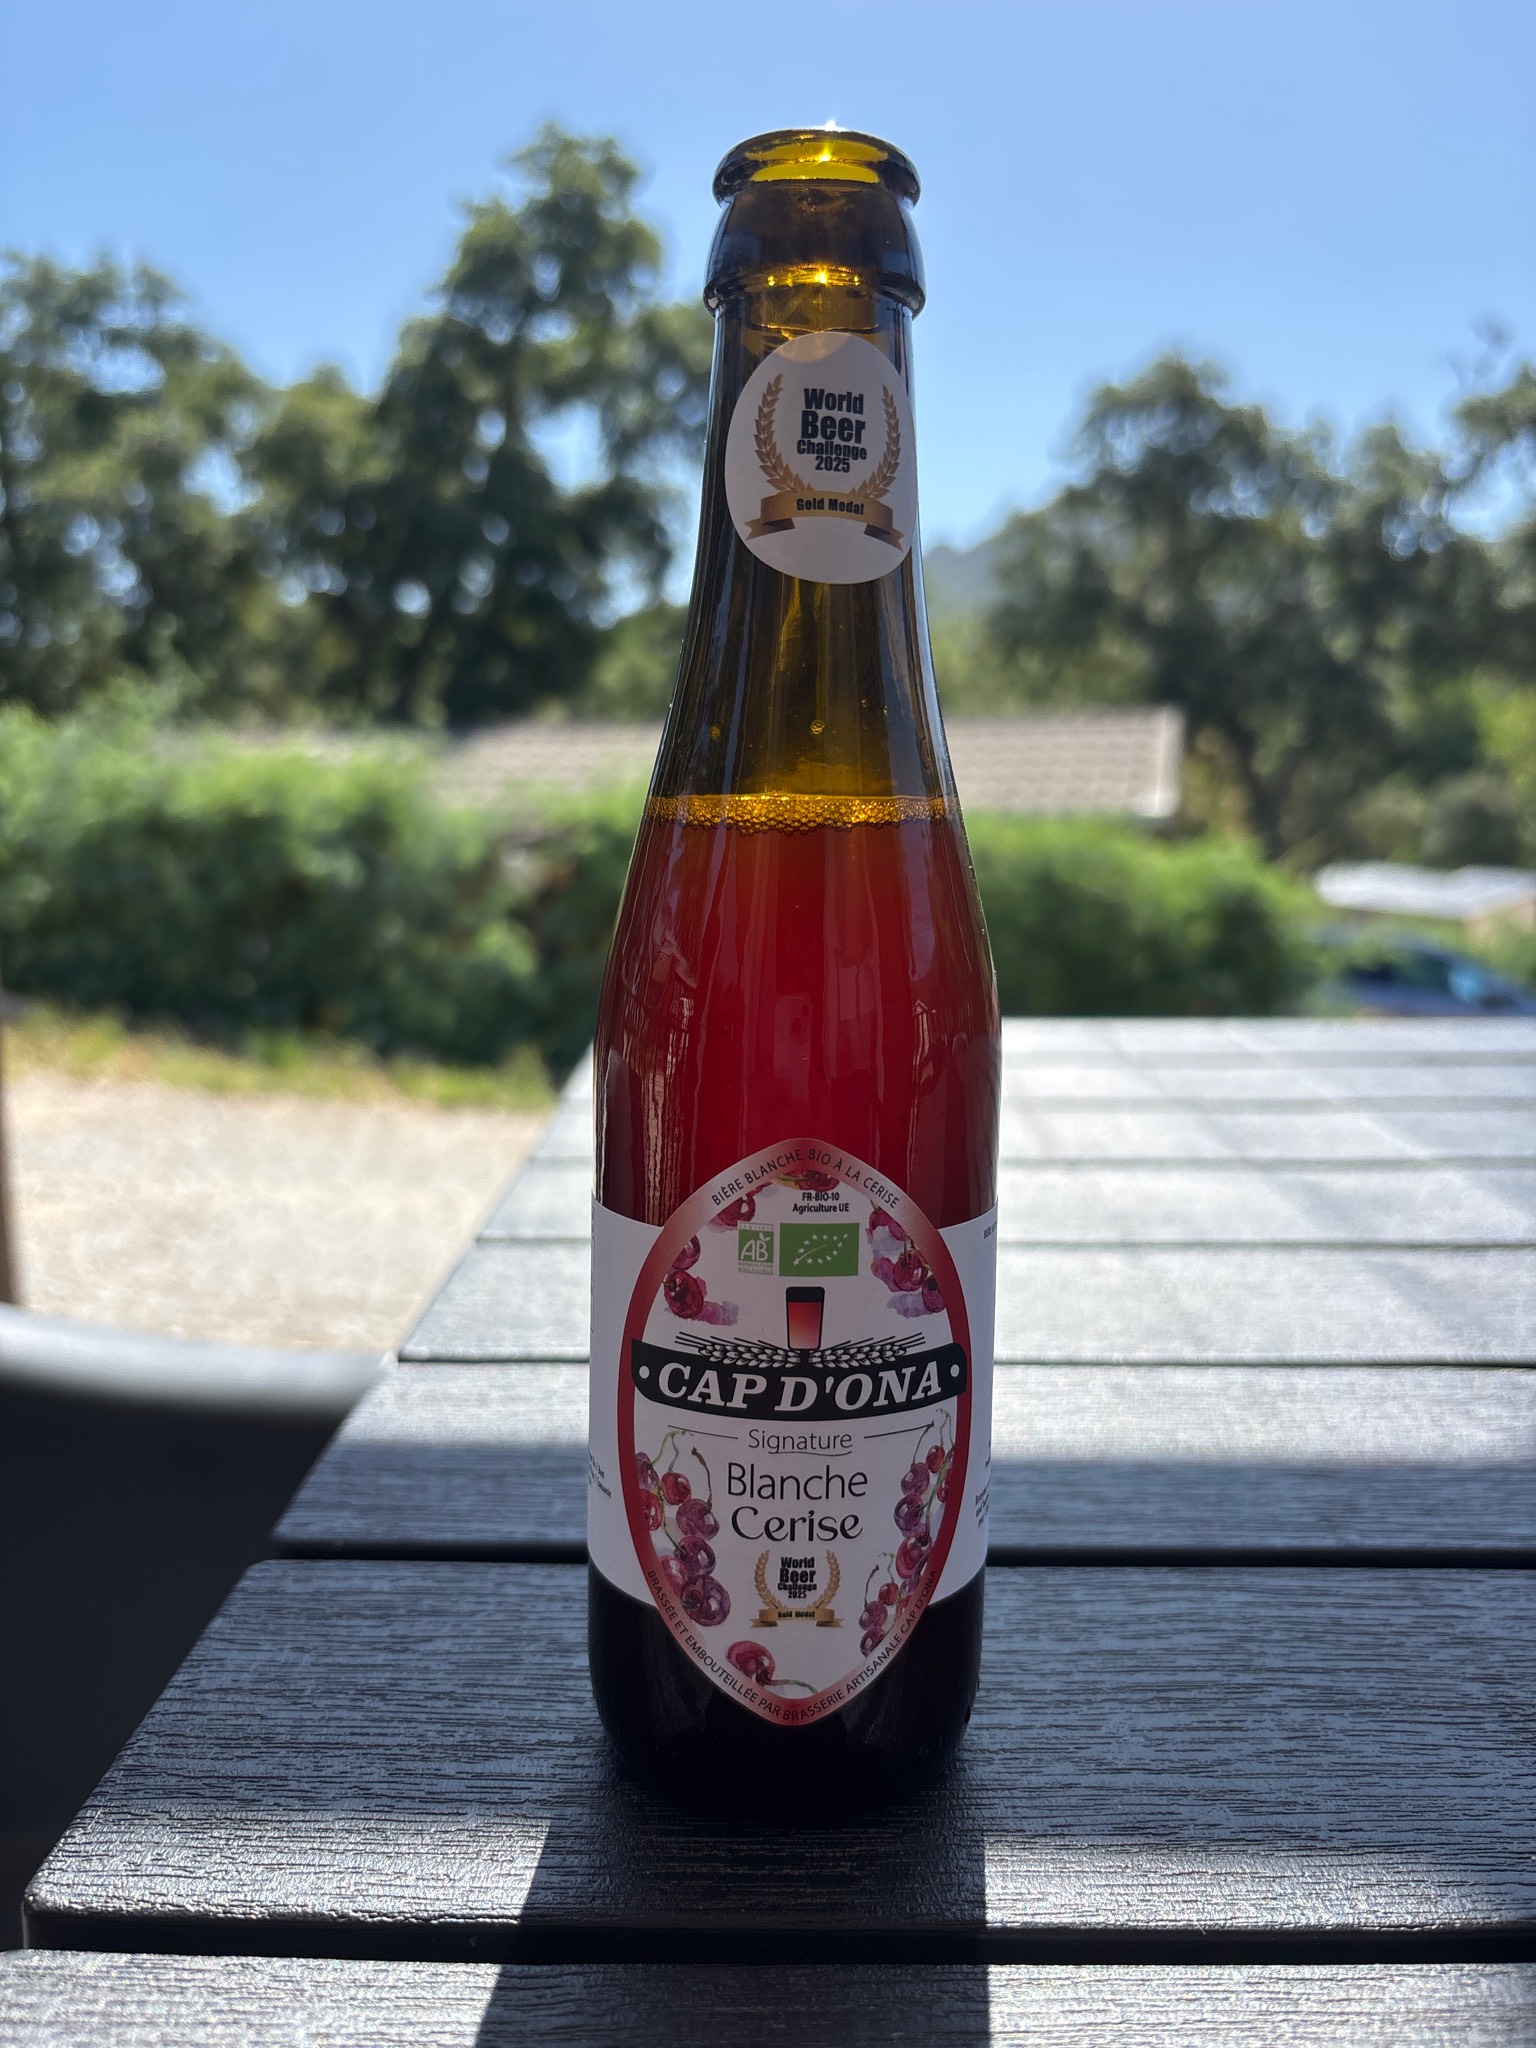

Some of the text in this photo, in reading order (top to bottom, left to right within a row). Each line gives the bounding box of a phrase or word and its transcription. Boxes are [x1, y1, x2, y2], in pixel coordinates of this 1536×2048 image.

[803, 388, 864, 415] World
[801, 410, 866, 444] Beer
[796, 439, 867, 461] Challenge
[815, 456, 850, 473] 2025
[796, 498, 865, 516] Gold Medal
[711, 1148, 899, 1209] BIÈRE BLANCHE BIO À LA CERISE
[802, 1191, 840, 1202] FR-BIO-10
[792, 1202, 850, 1215] Agriculture UE
[740, 1239, 769, 1261] AB
[657, 1360, 943, 1412] CAP D'ONA
[748, 1429, 853, 1454] Signature
[727, 1462, 868, 1501] Blanche
[731, 1506, 863, 1542] Cerise
[780, 1556, 815, 1569] World
[780, 1567, 816, 1583] Beer
[777, 1582, 817, 1591] Challenge
[788, 1590, 807, 1599] 2025
[777, 1610, 815, 1618] Gold Medal
[647, 1570, 937, 1722] BRASSÉE ET EMBOUTEILLÉE PAR BRASSERIE ARTISANALE CAP D'ONA
